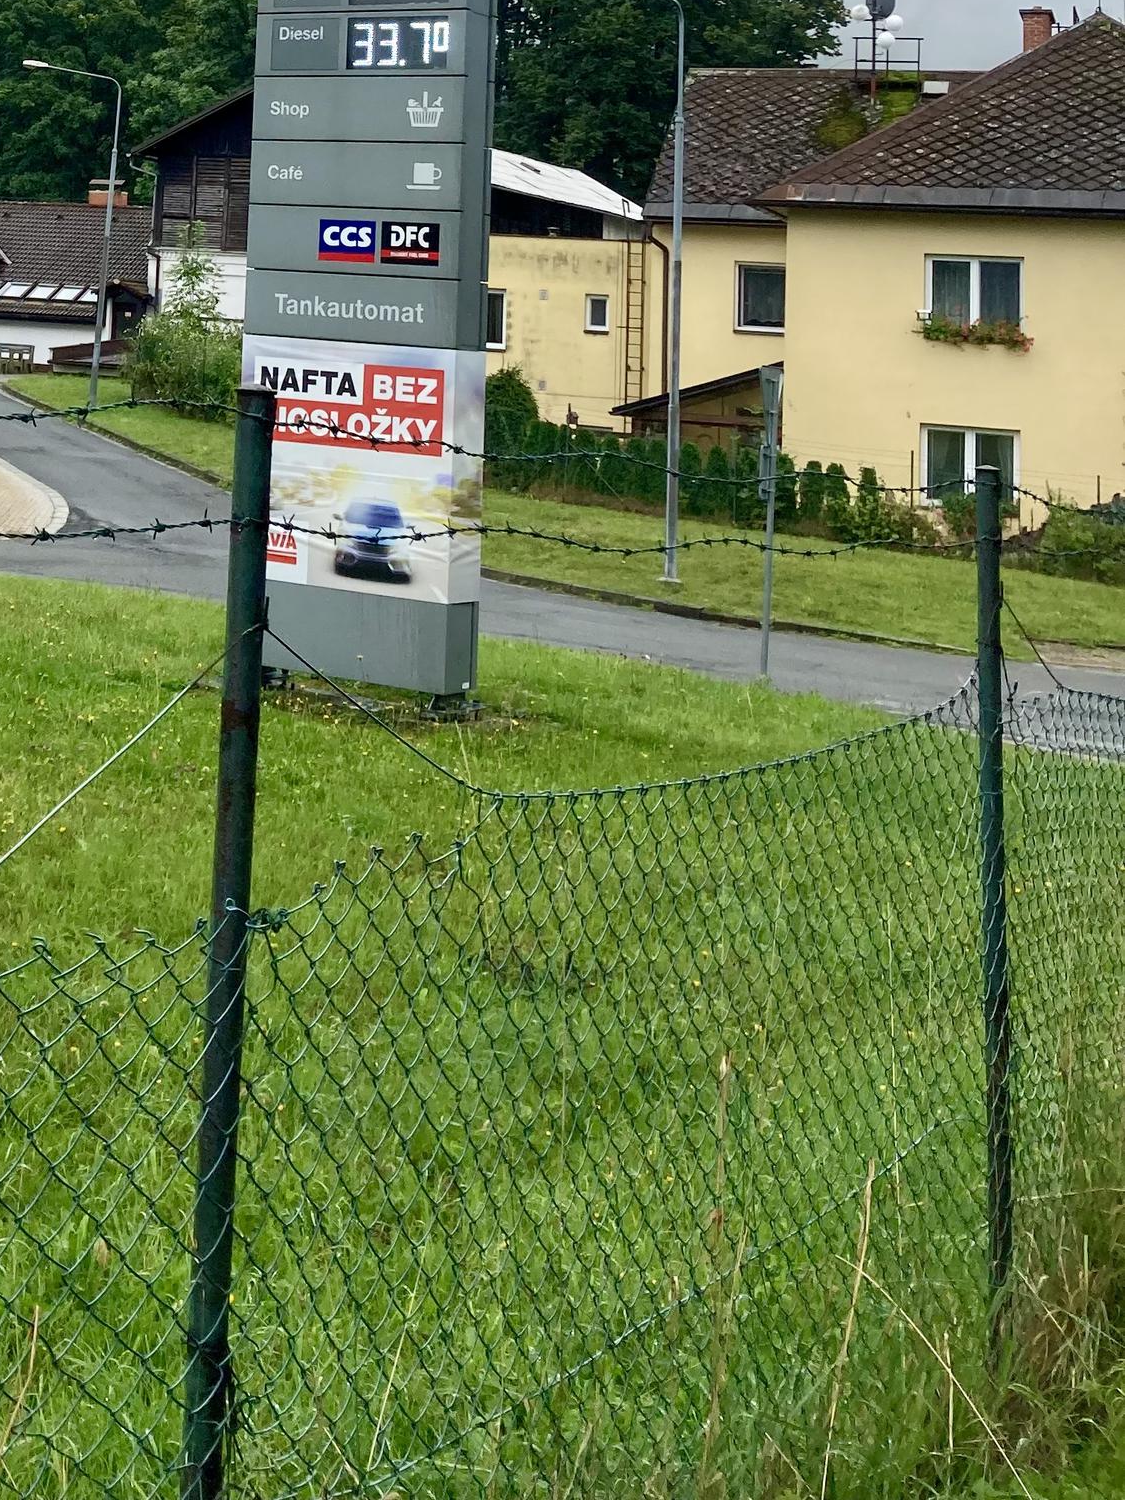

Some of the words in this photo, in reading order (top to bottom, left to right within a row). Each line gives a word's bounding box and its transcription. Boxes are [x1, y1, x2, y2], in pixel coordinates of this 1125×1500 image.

[278, 26, 324, 41] Diesel
[352, 21, 450, 66] 33.70
[269, 100, 310, 118] Shop
[267, 164, 303, 180] Café
[323, 225, 372, 248] CCS
[390, 225, 430, 248] DFC
[274, 292, 425, 324] Tankautomat
[260, 365, 358, 398] NAFTA
[372, 373, 438, 405] BEZ
[274, 406, 438, 446] IOSLOŽKY
[267, 531, 297, 550] VIA
